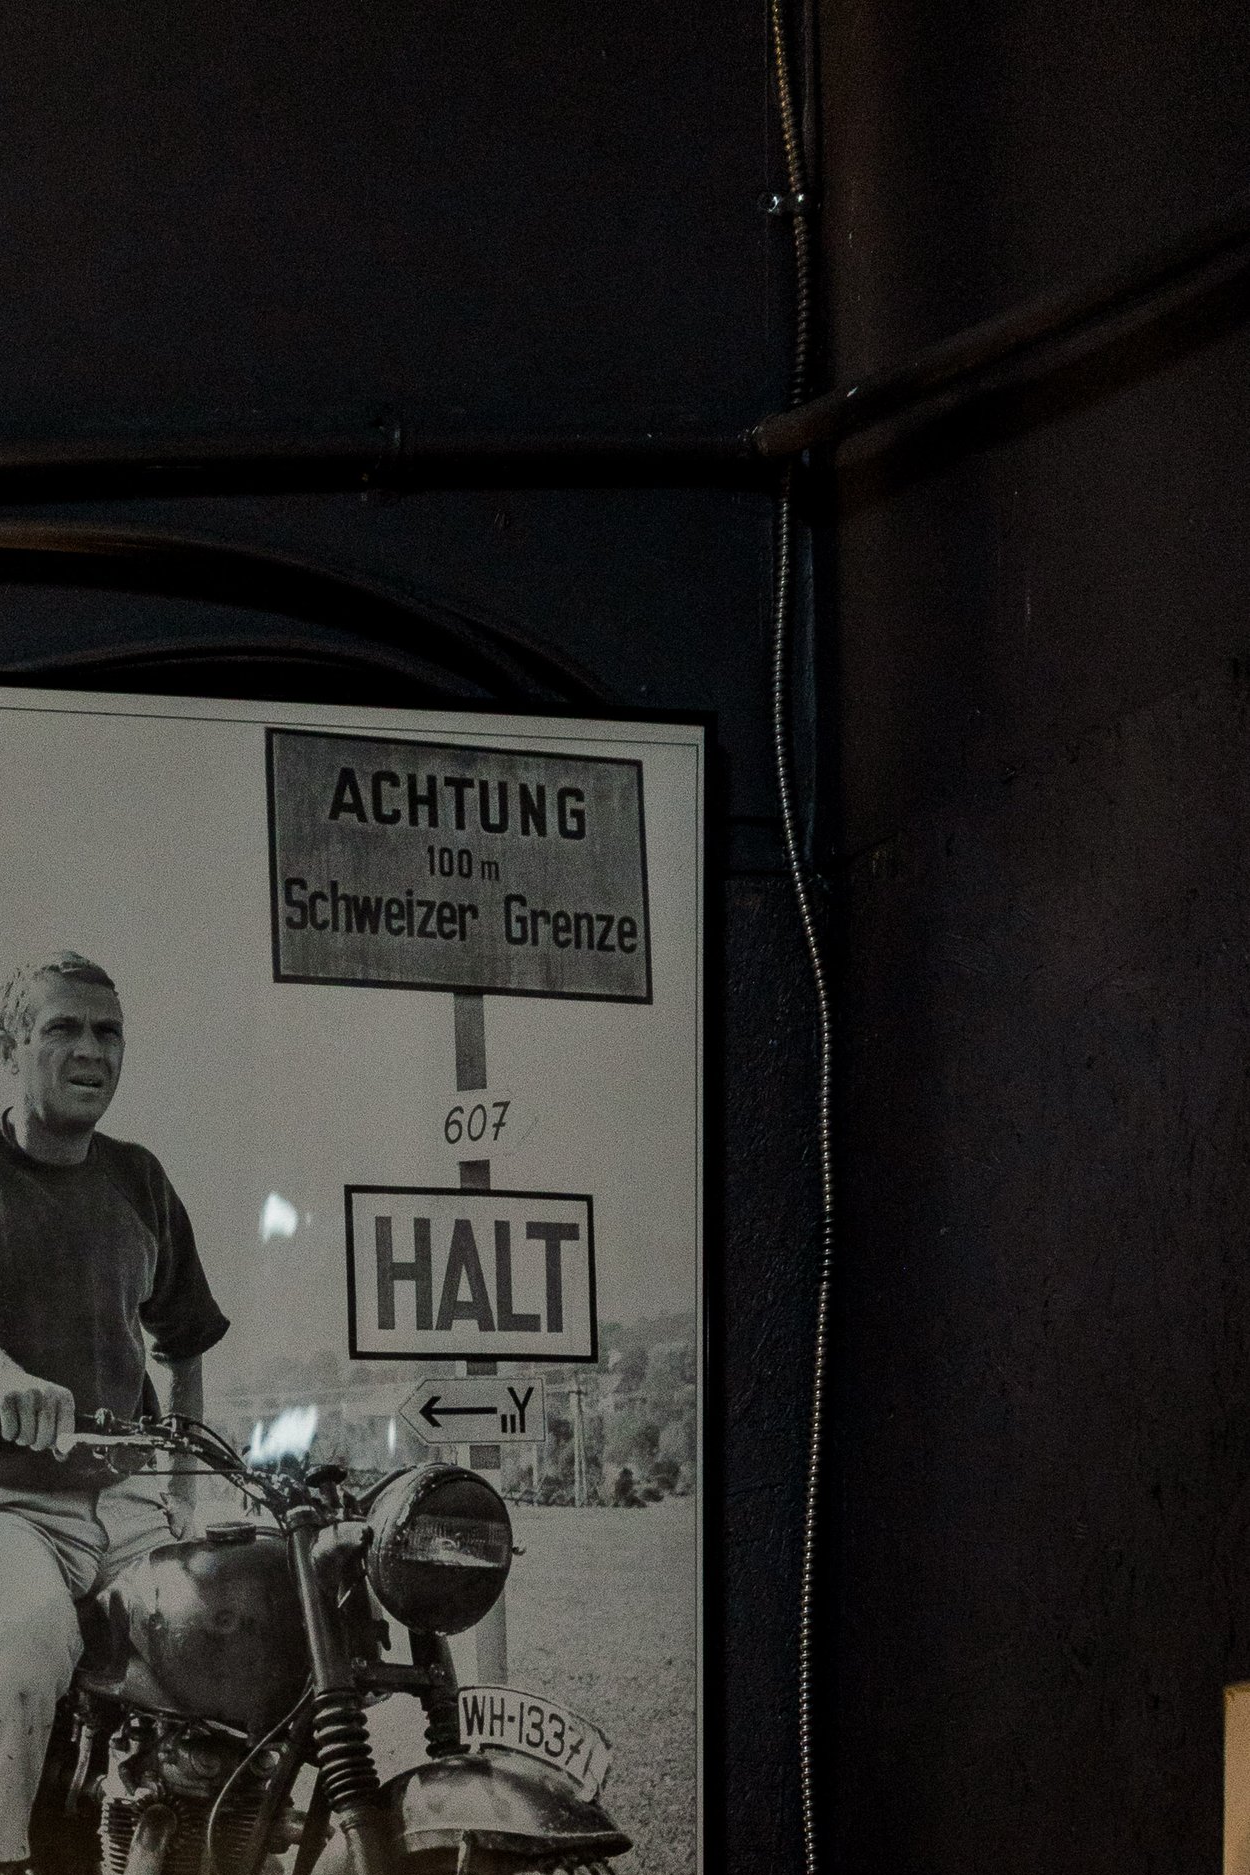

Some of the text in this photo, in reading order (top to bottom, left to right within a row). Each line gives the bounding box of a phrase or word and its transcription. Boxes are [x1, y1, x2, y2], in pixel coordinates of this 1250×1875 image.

[328, 767, 586, 840] ACHTUNG
[426, 845, 499, 881] 100 m
[284, 877, 638, 953] Schweizer Grenze
[444, 1100, 511, 1144] 607
[375, 1216, 580, 1333] HALT
